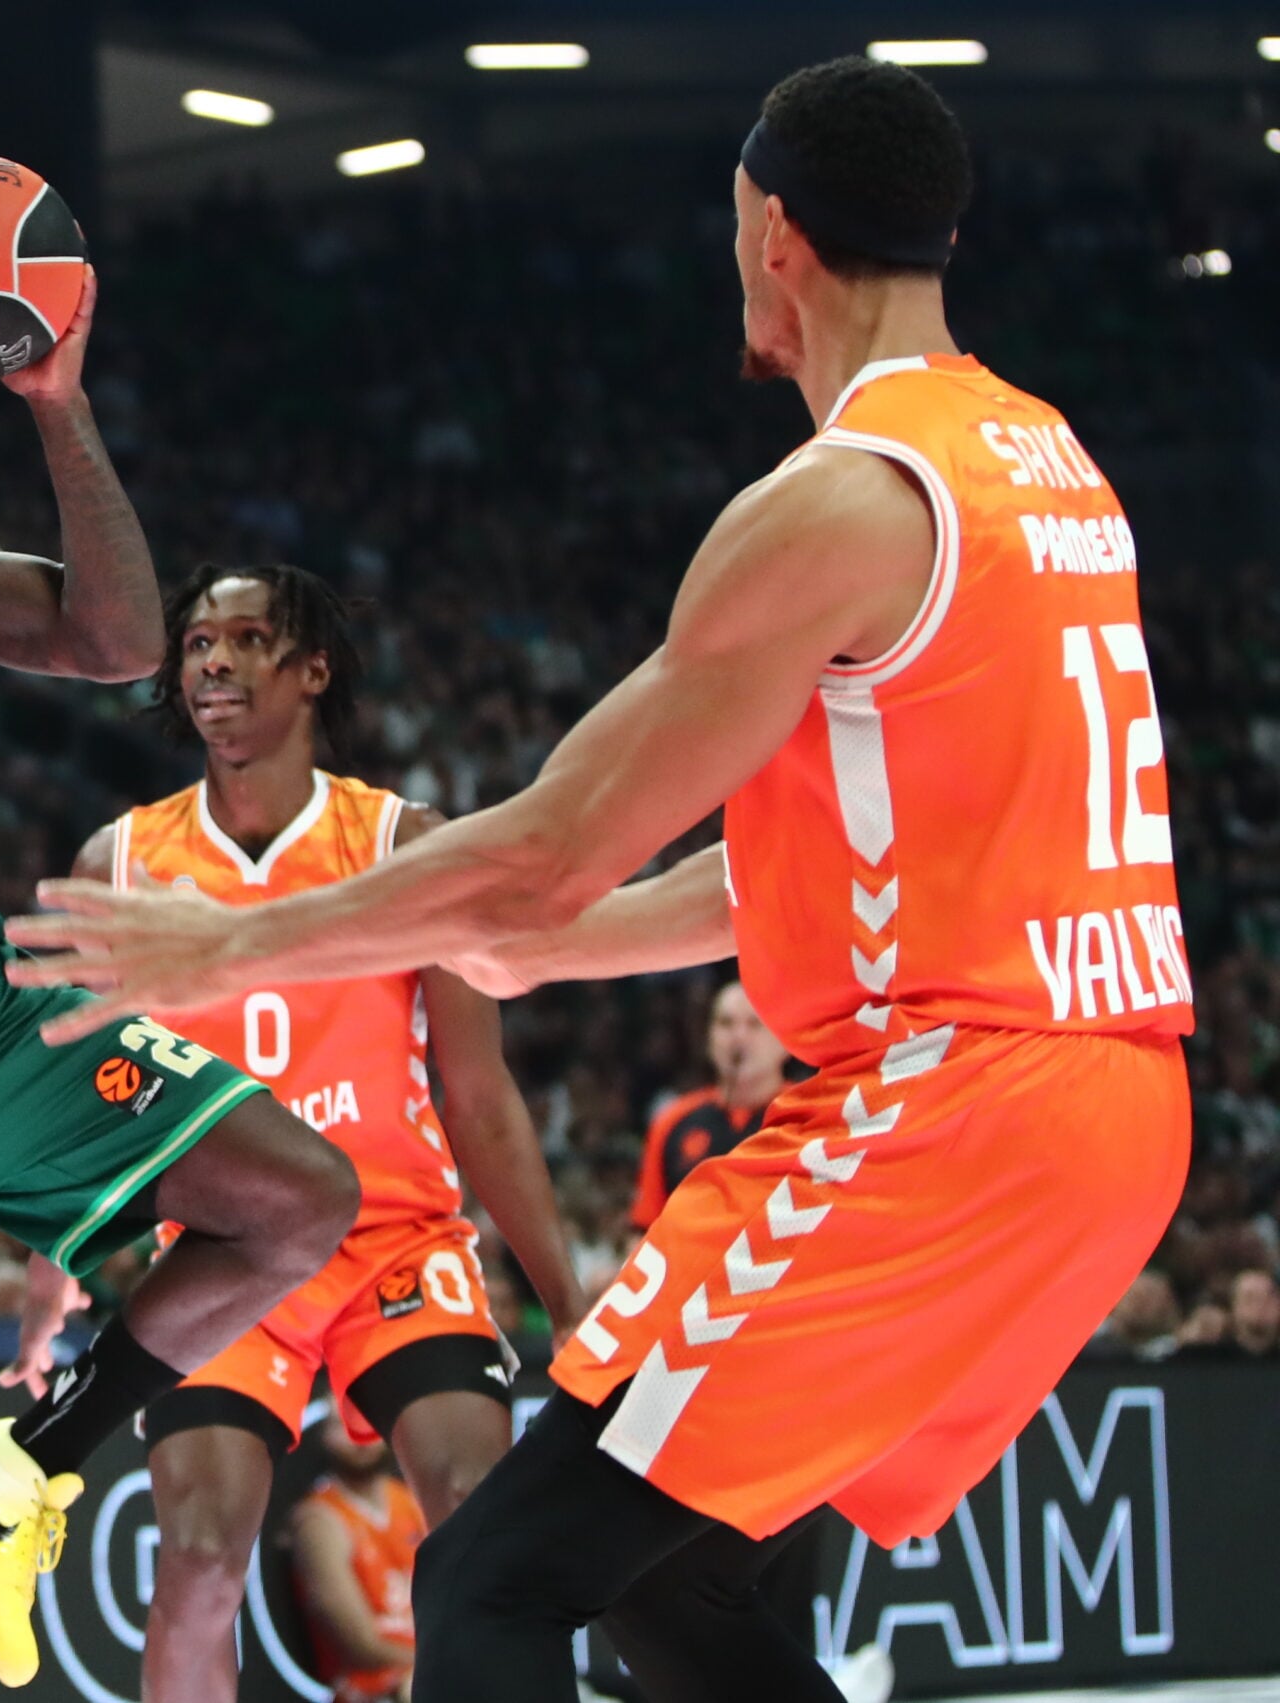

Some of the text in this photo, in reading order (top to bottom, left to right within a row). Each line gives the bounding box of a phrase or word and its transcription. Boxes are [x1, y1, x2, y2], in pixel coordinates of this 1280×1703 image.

[980, 422, 1101, 489] SAKO
[1019, 513, 1137, 574] PAMESA
[1062, 623, 1174, 870] 12
[120, 1016, 222, 1079] 2
[244, 991, 291, 1077] 0
[423, 1250, 474, 1316] 0
[575, 1240, 667, 1364] 2
